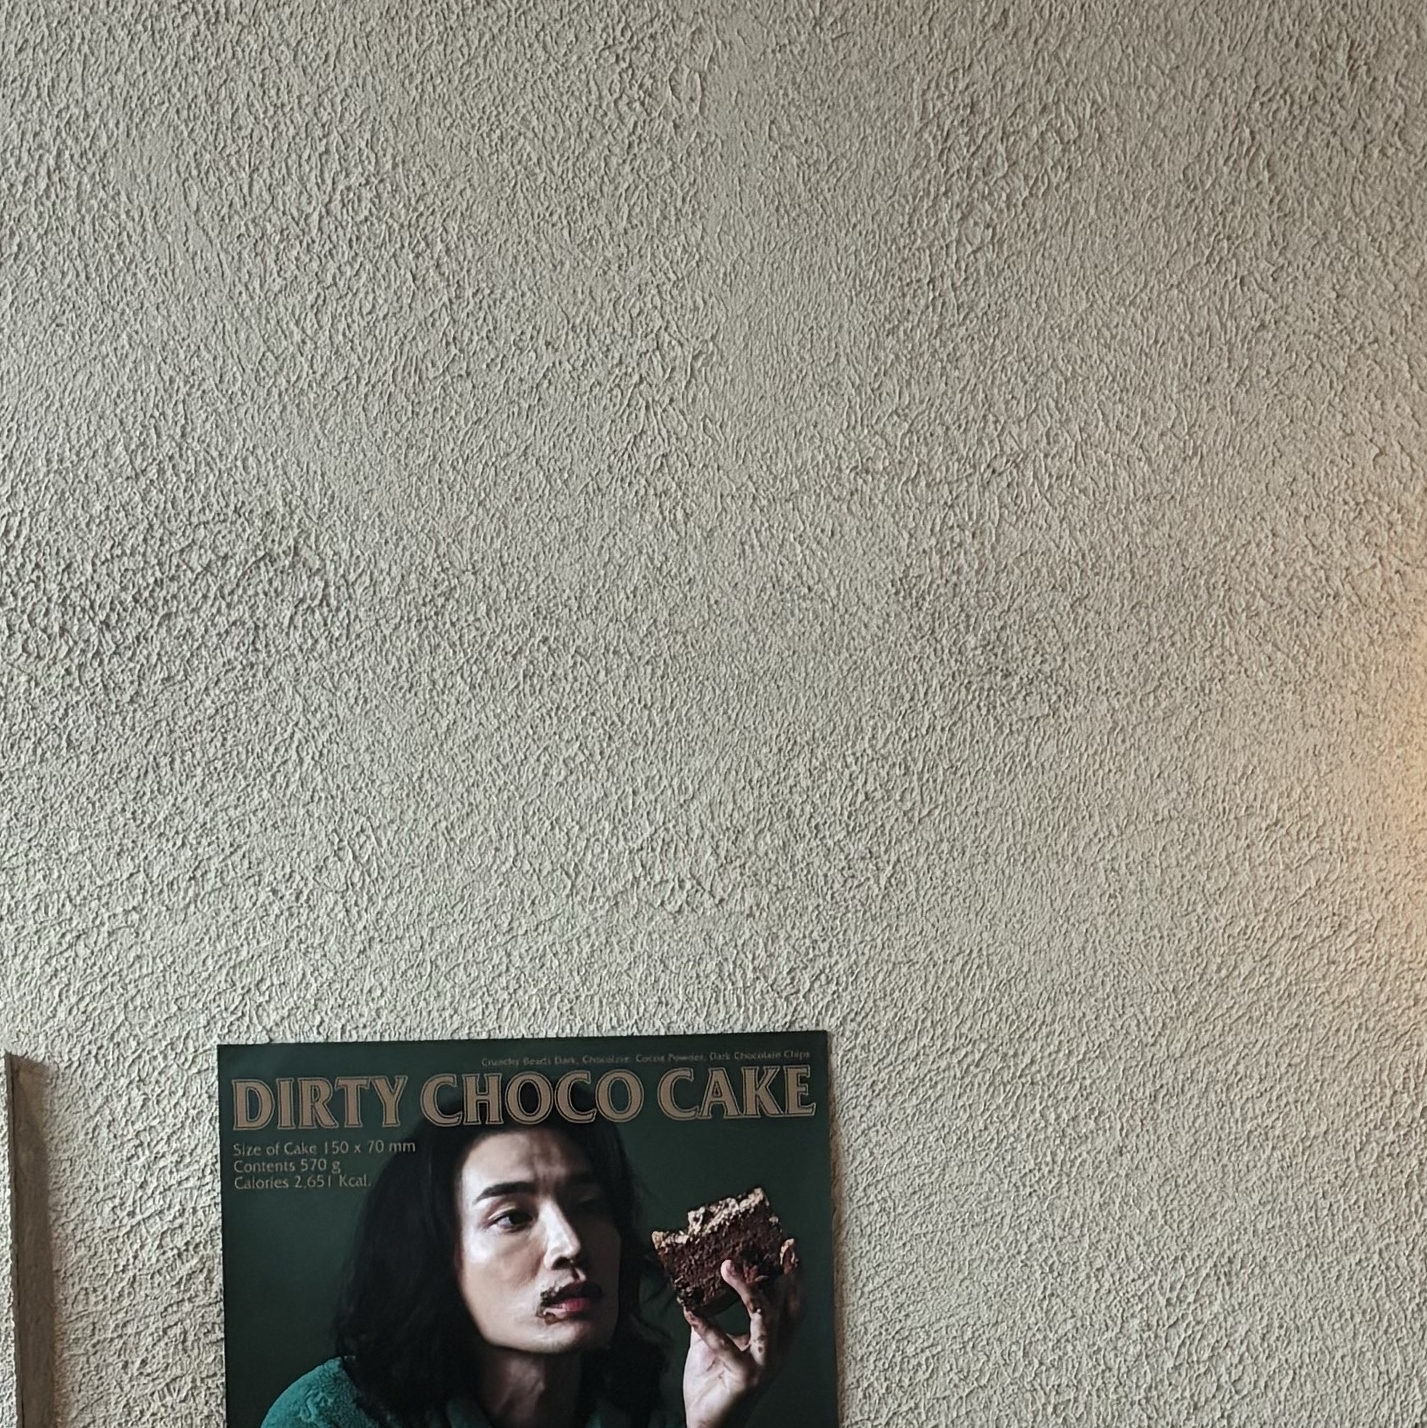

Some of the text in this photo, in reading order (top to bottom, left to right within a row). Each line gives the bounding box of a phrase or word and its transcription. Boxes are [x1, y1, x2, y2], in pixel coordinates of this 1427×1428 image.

[231, 1064, 817, 1132] DIRTY CHOCO CAKE
[233, 1139, 416, 1157] Size of Cake 150 x 70 mm
[233, 1158, 342, 1175] Contents 570 g
[234, 1175, 290, 1190] Calories
